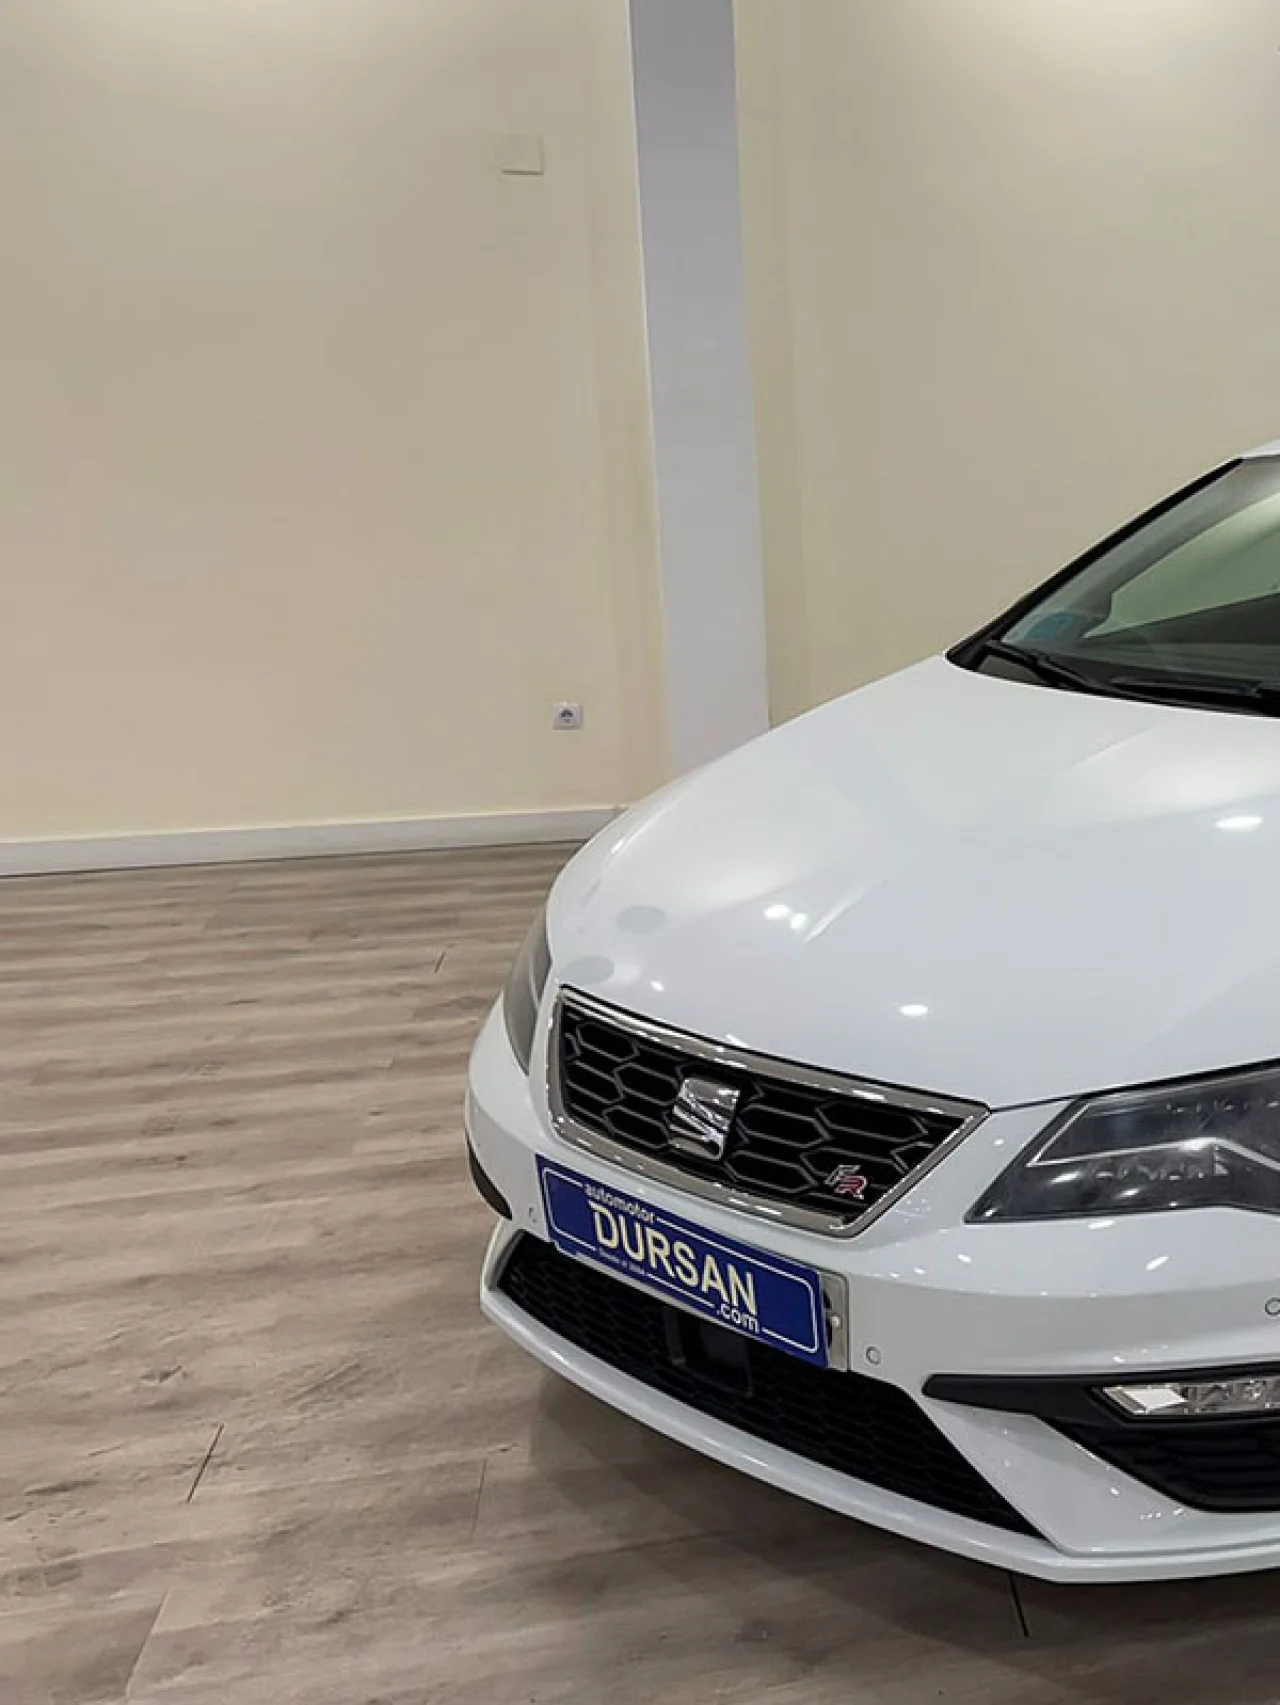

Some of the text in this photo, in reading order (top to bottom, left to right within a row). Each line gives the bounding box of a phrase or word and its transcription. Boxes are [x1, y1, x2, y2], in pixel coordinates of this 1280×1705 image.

[584, 1184, 656, 1223] automotor
[589, 1201, 756, 1315] DURSAN
[717, 1303, 759, 1334] .com
